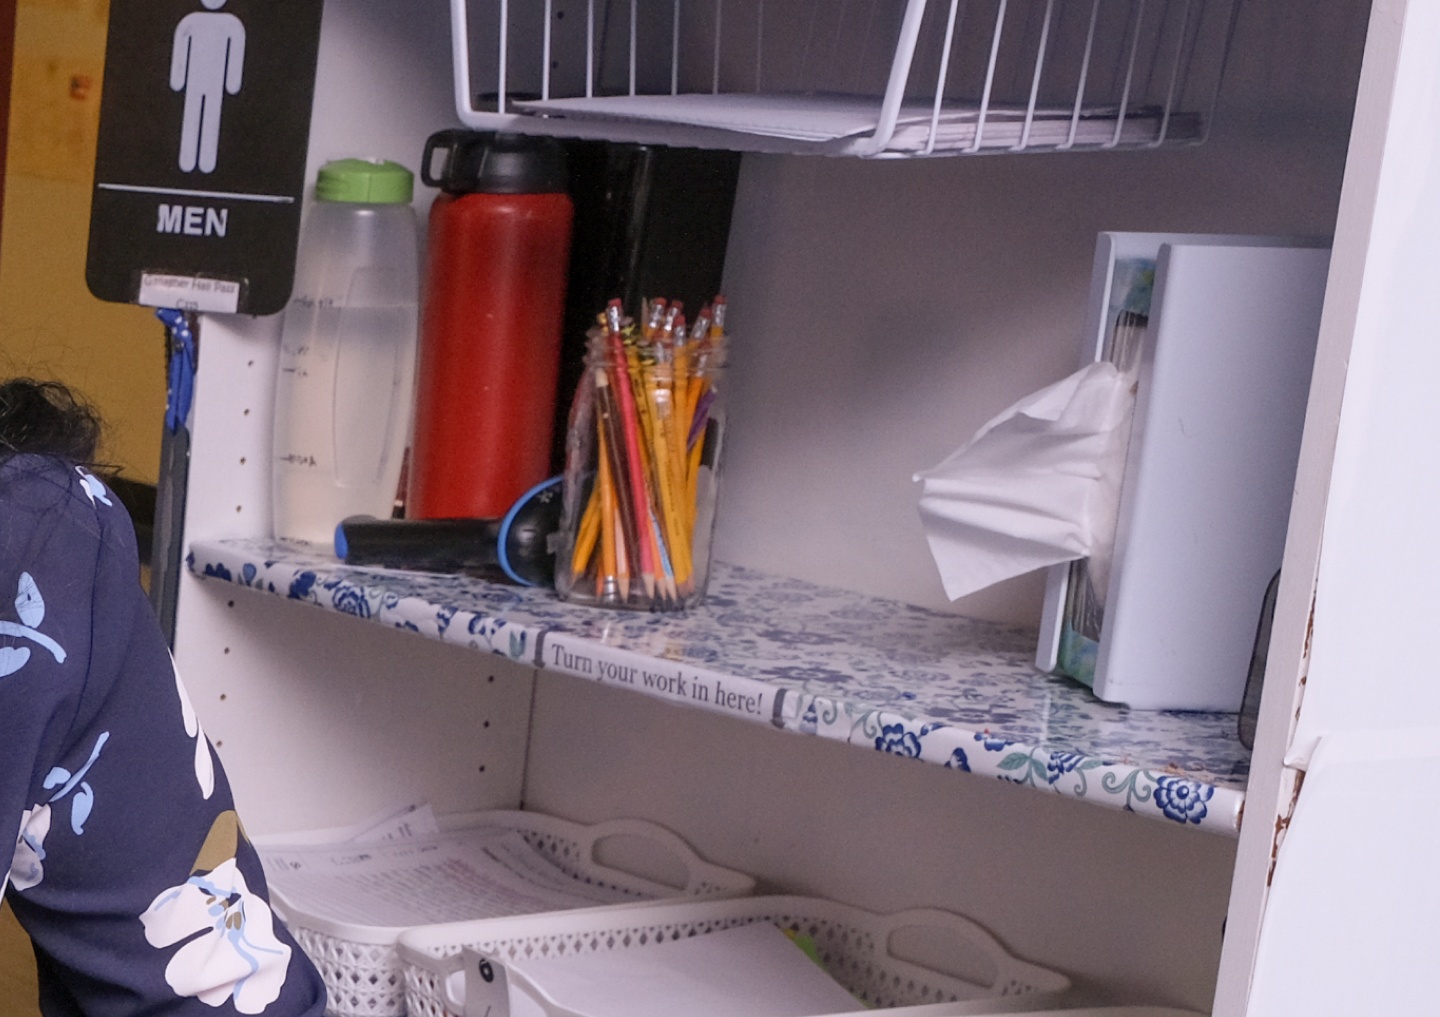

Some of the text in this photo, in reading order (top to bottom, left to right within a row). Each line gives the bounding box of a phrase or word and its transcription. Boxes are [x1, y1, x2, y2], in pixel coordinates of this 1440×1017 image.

[157, 204, 228, 237] MEN
[551, 643, 763, 715] Turn your work in here!
